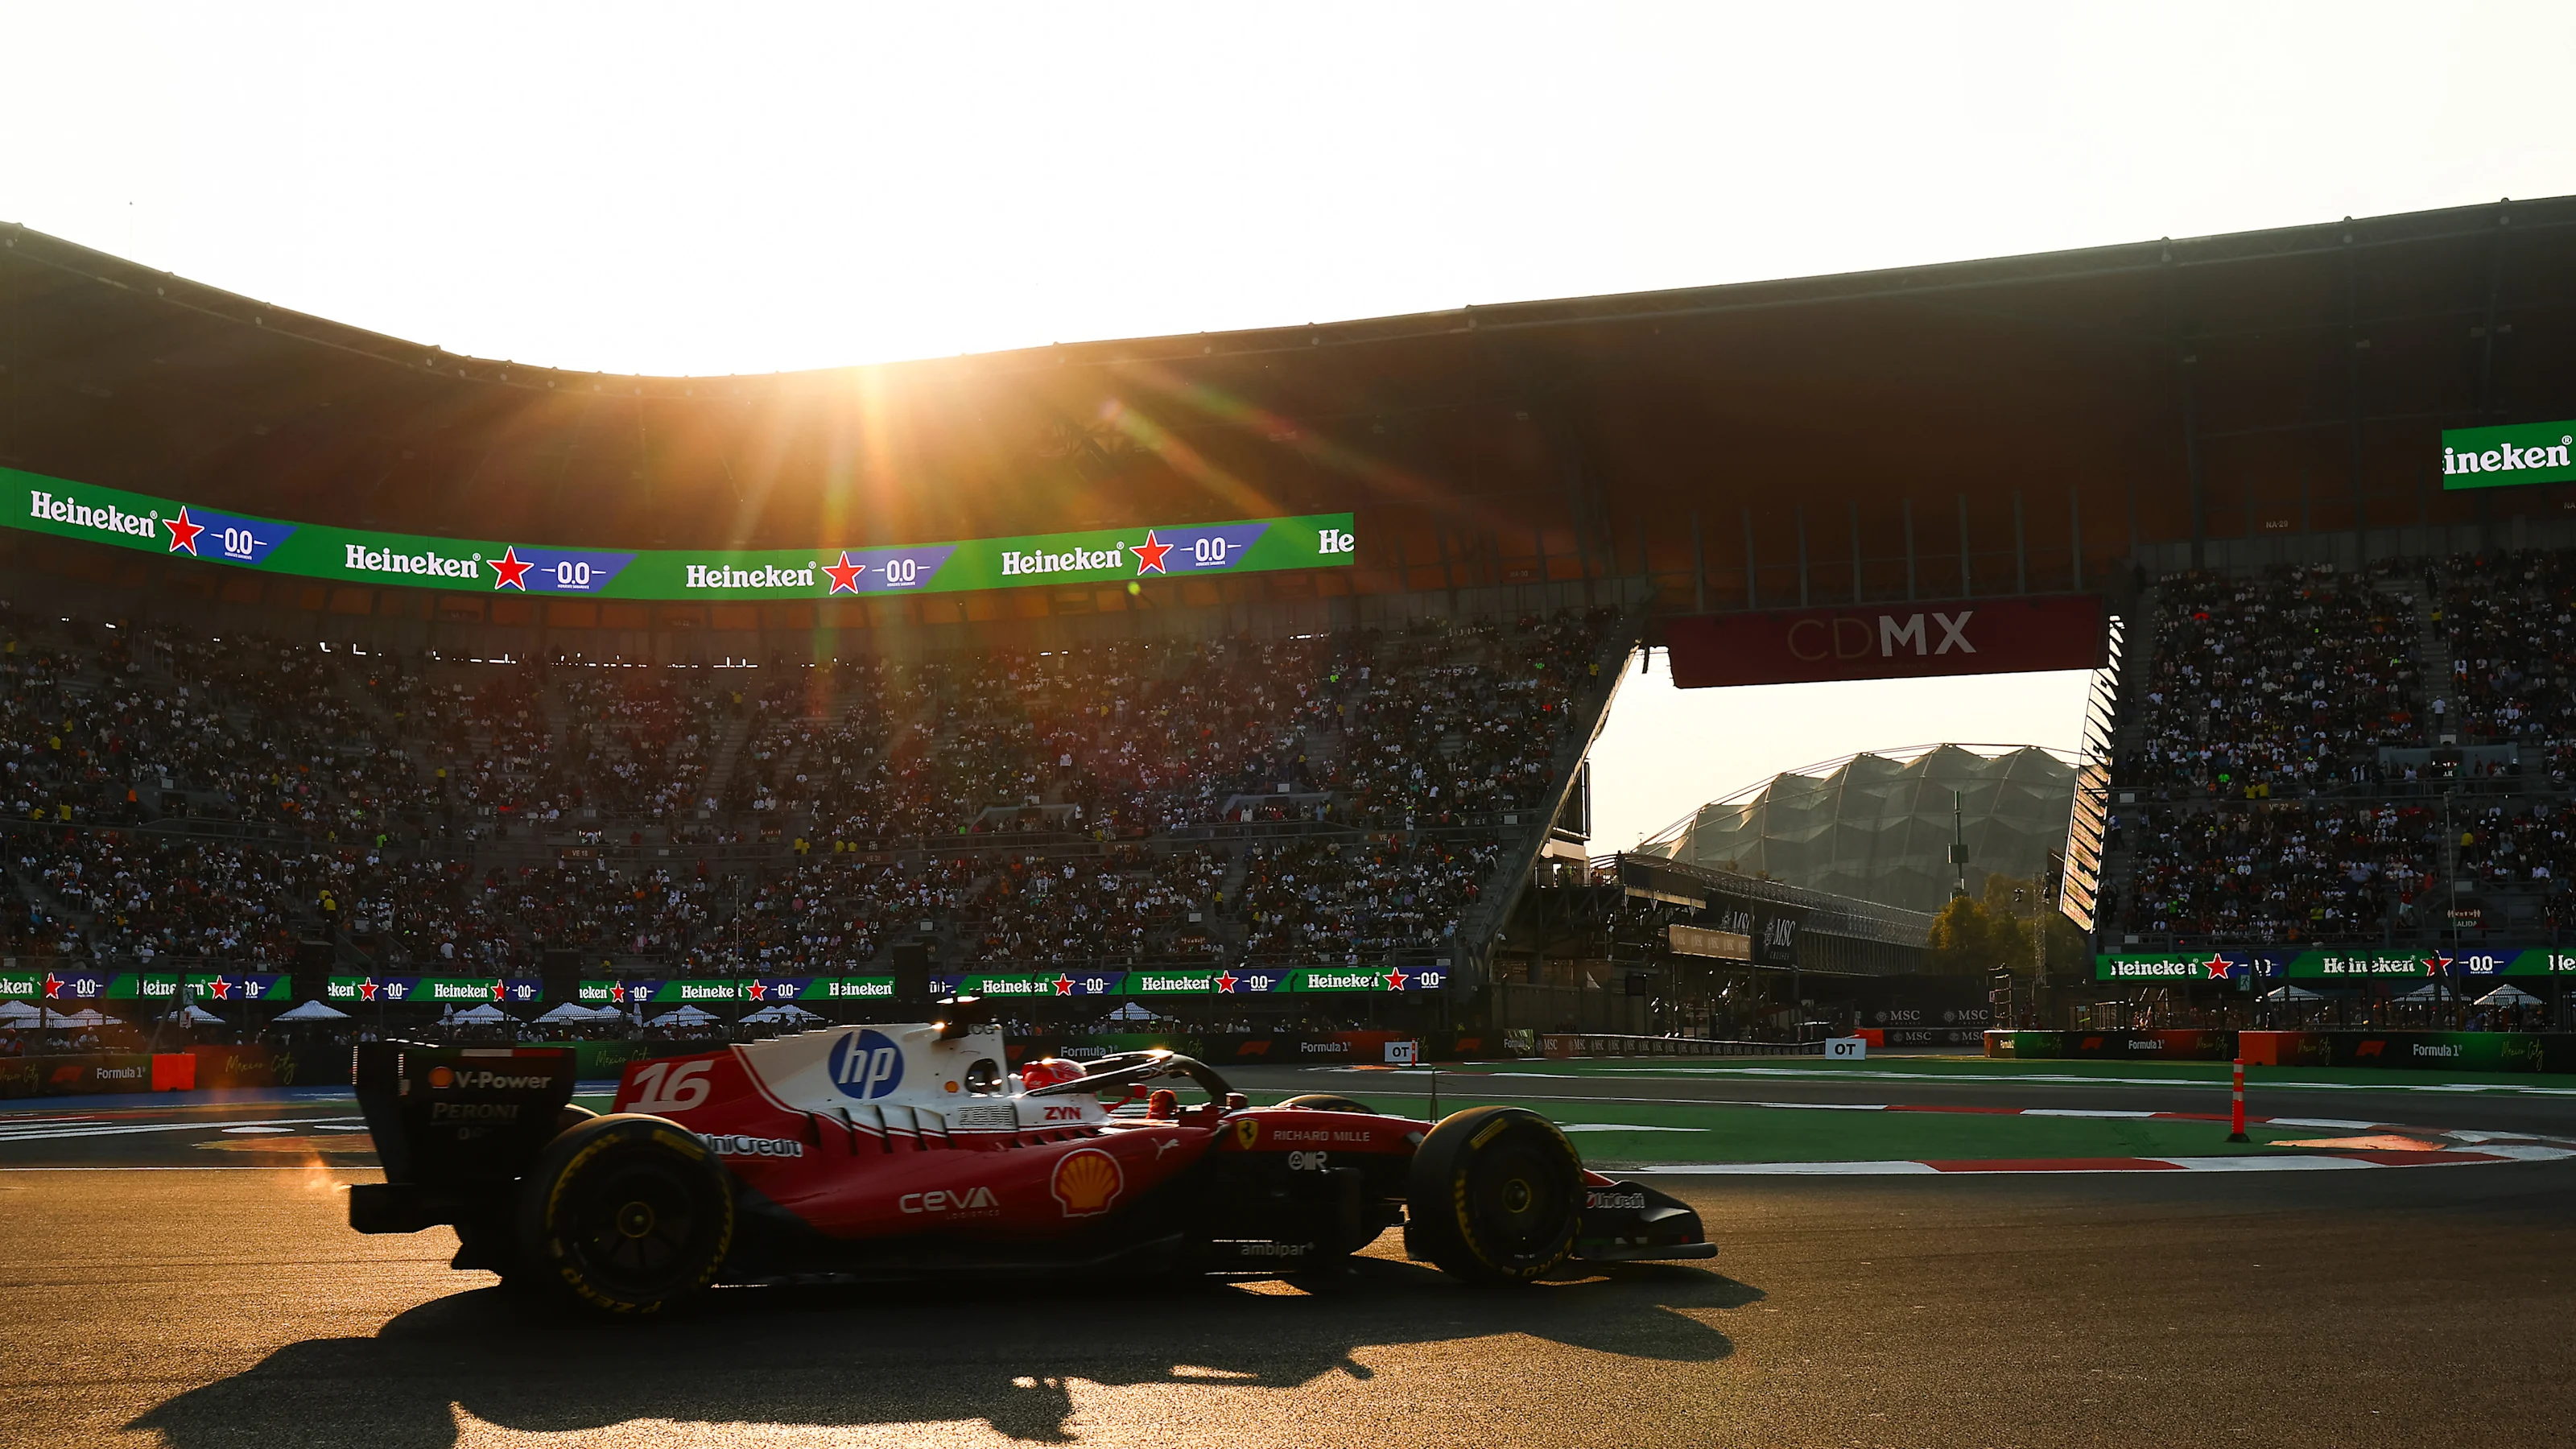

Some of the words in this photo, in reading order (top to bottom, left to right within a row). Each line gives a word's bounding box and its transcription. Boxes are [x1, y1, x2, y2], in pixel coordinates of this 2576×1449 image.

[1318, 528, 1354, 555] He
[1787, 611, 1977, 661] CDMX
[1773, 918, 1796, 947] MSC
[1890, 1009, 1921, 1021] MSC
[1958, 1009, 1988, 1021] MSC
[1905, 1031, 1932, 1041] MSC
[1300, 1042, 1341, 1052] Formula
[1834, 1043, 1856, 1055] OT
[2128, 1039, 2157, 1050] Formula
[2413, 1043, 2451, 1057] Formula
[1061, 1046, 1107, 1057] Formula
[1392, 1046, 1410, 1058] OT
[837, 1030, 896, 1099] hp
[97, 1067, 135, 1080] Formula
[455, 1071, 552, 1090] V-Power
[624, 1060, 715, 1113] 16
[958, 1105, 1014, 1125] IBM
[1044, 1107, 1081, 1120] ZYN
[1273, 1130, 1328, 1141] RICHARD
[1332, 1131, 1371, 1142] MILLE
